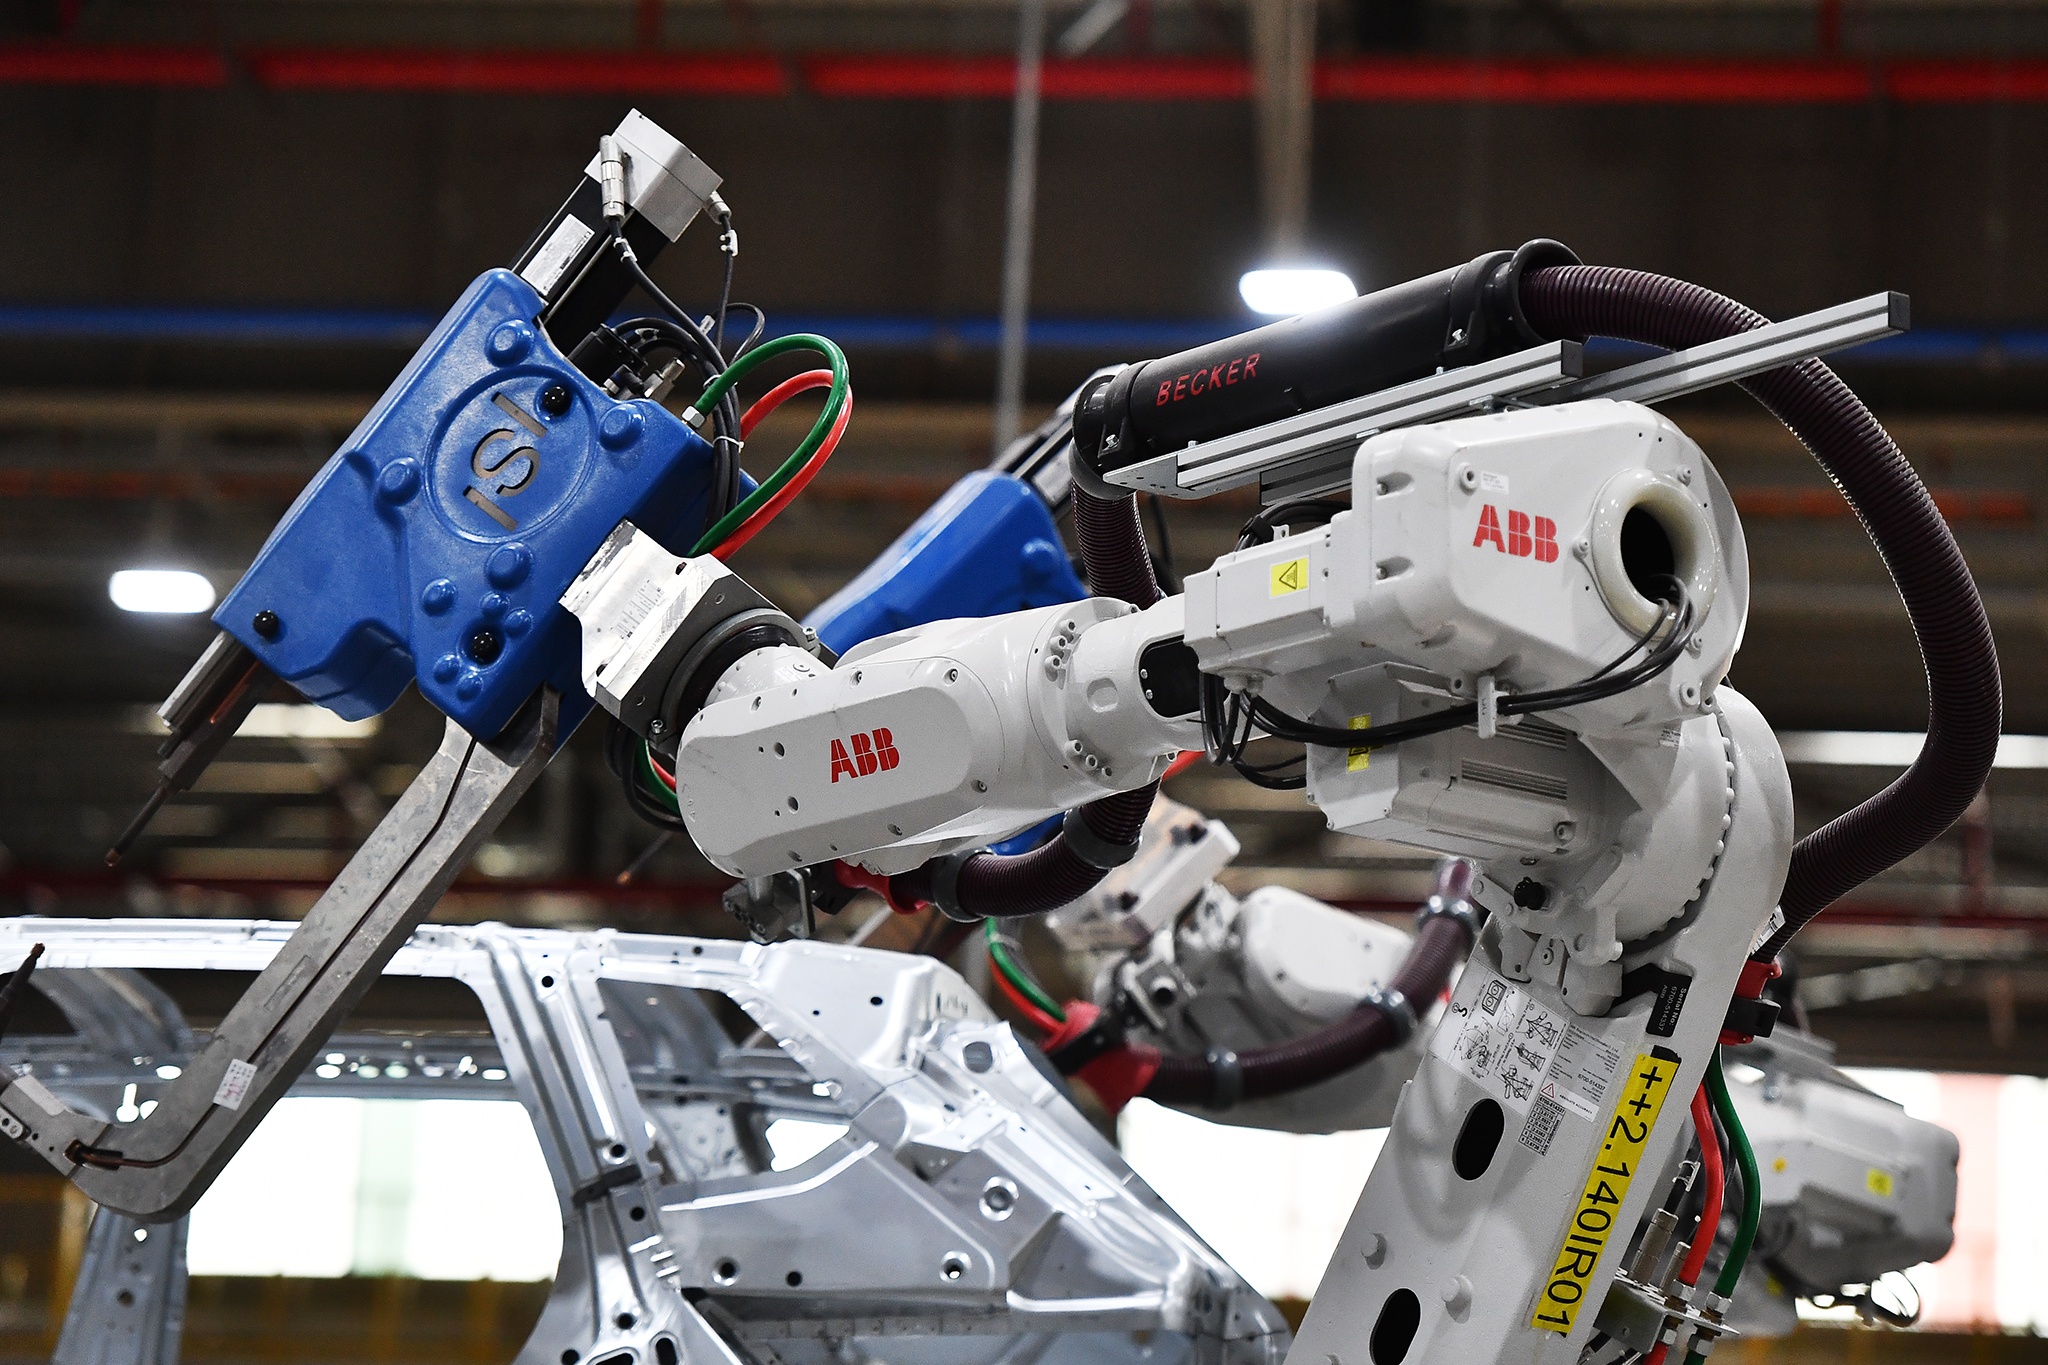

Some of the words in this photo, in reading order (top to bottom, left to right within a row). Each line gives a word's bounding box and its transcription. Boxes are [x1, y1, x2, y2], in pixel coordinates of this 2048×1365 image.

[1156, 353, 1261, 406] BECKER
[462, 391, 548, 532] ISI
[1473, 504, 1559, 563] ABB
[831, 727, 900, 783] ABB
[1657, 985, 1678, 1031] 6700-514337
[1668, 1011, 1679, 1026] No:
[1674, 987, 1687, 1011] Serial
